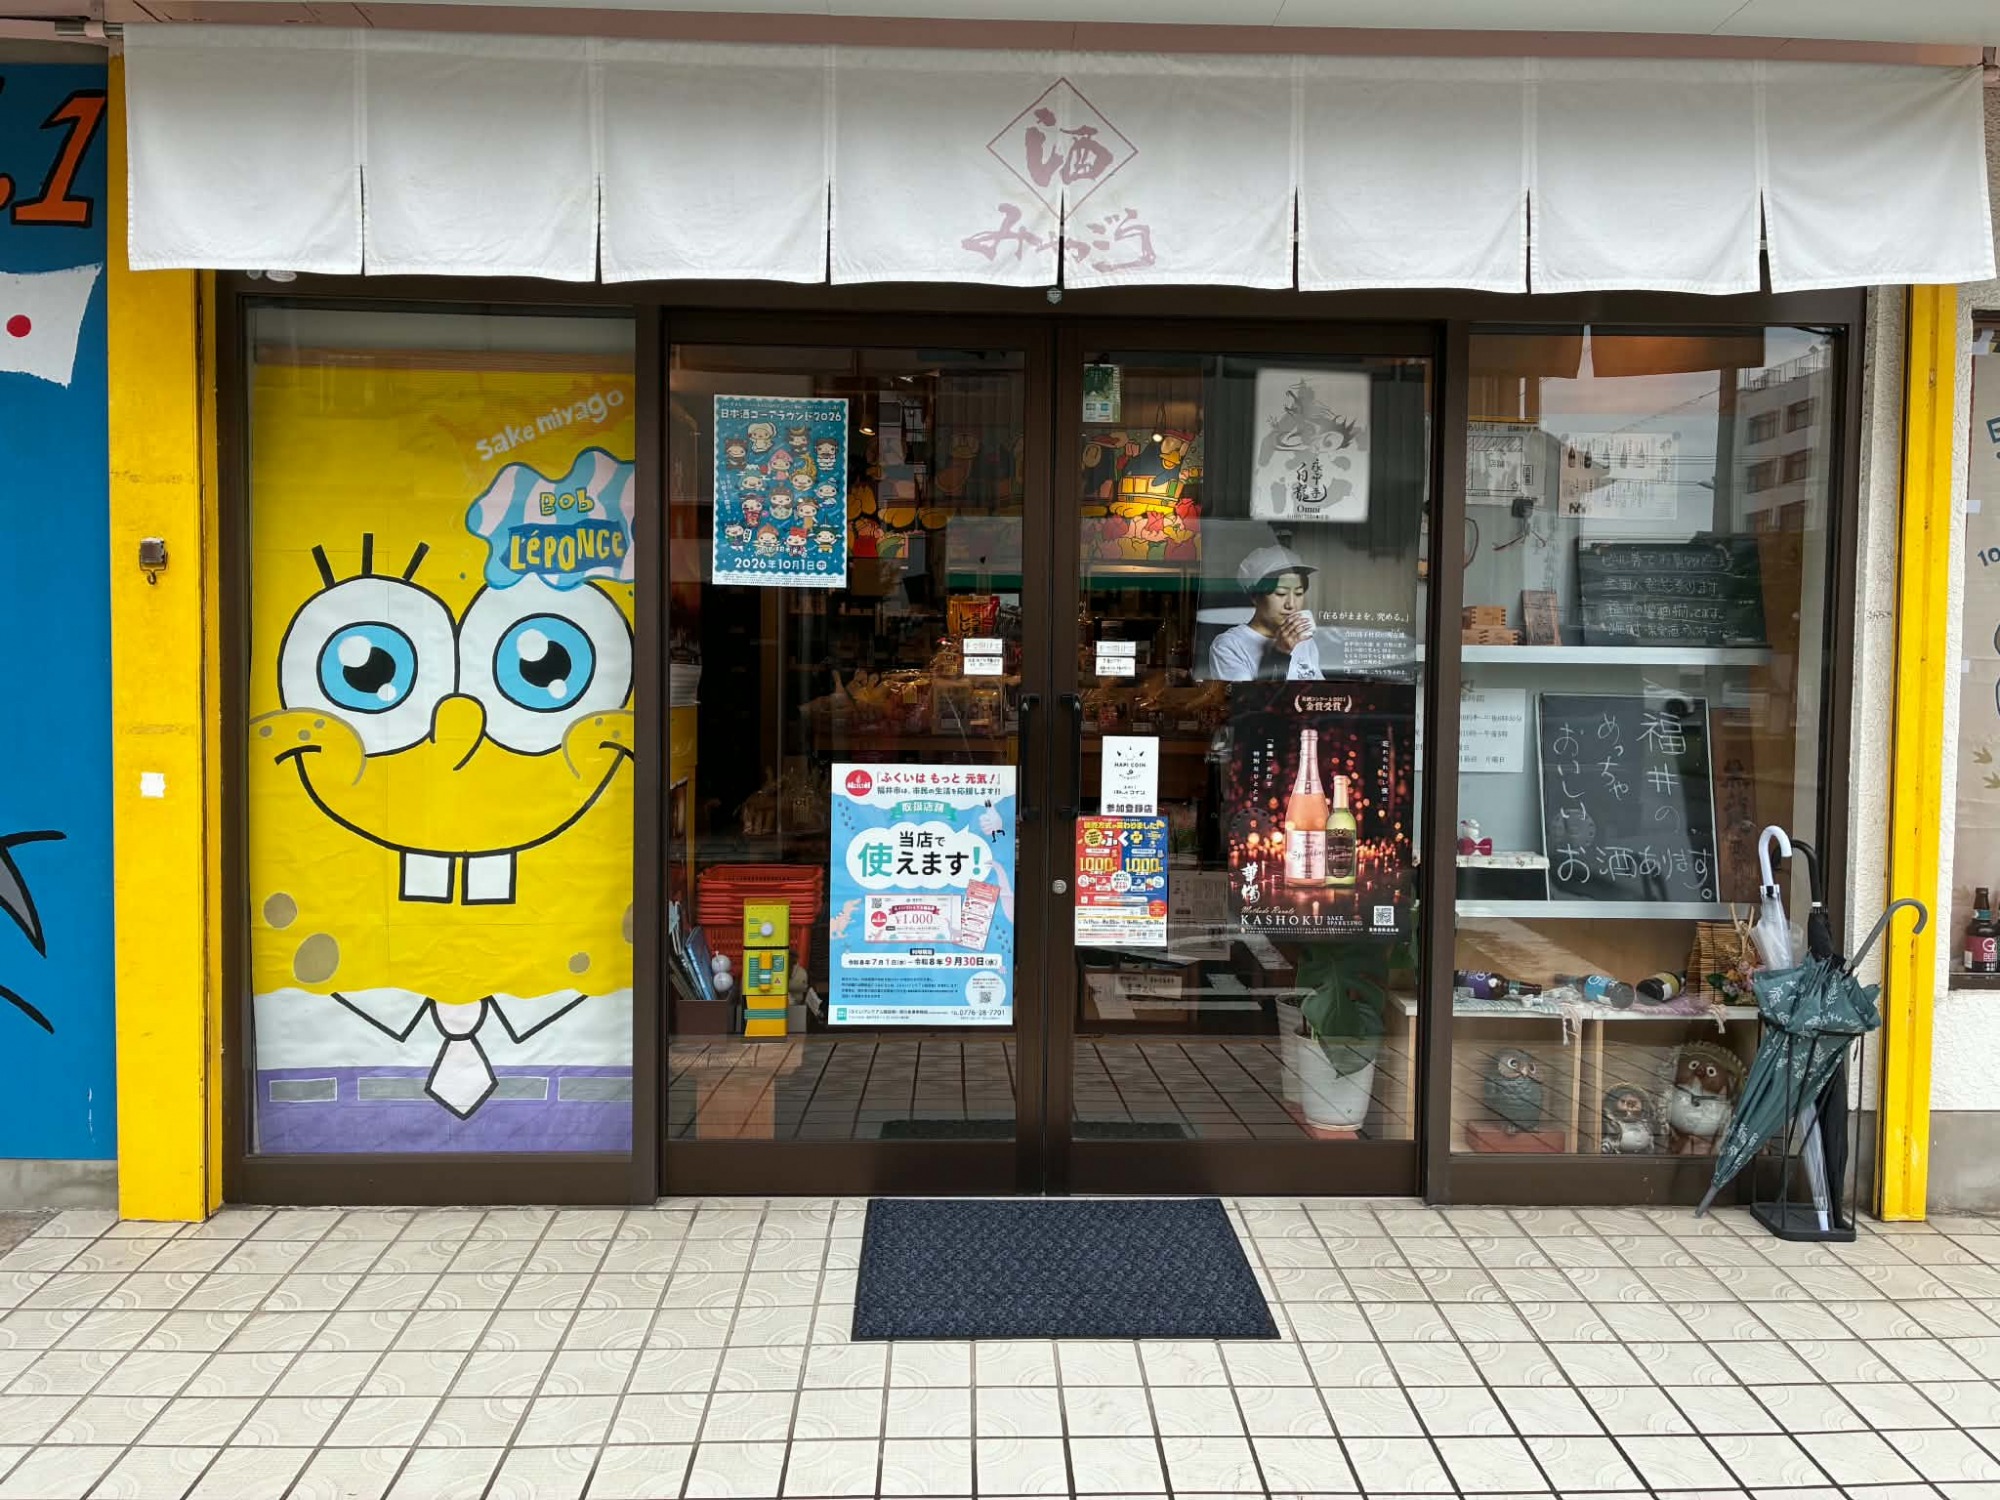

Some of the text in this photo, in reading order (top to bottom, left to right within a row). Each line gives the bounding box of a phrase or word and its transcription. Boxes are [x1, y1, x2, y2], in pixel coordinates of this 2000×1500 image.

[1024, 107, 1114, 188] 酒
[476, 390, 624, 460] Sake miyago
[539, 488, 594, 516] Bob
[1553, 722, 1586, 821] おいしい
[1597, 713, 1630, 801] めっちゃ
[1636, 712, 1687, 834] 福井の
[899, 830, 946, 848] 当店で
[1106, 803, 1153, 813] 参加登録店
[1556, 843, 1712, 899] お酒あります。
[1241, 915, 1324, 926] KASHOKU
